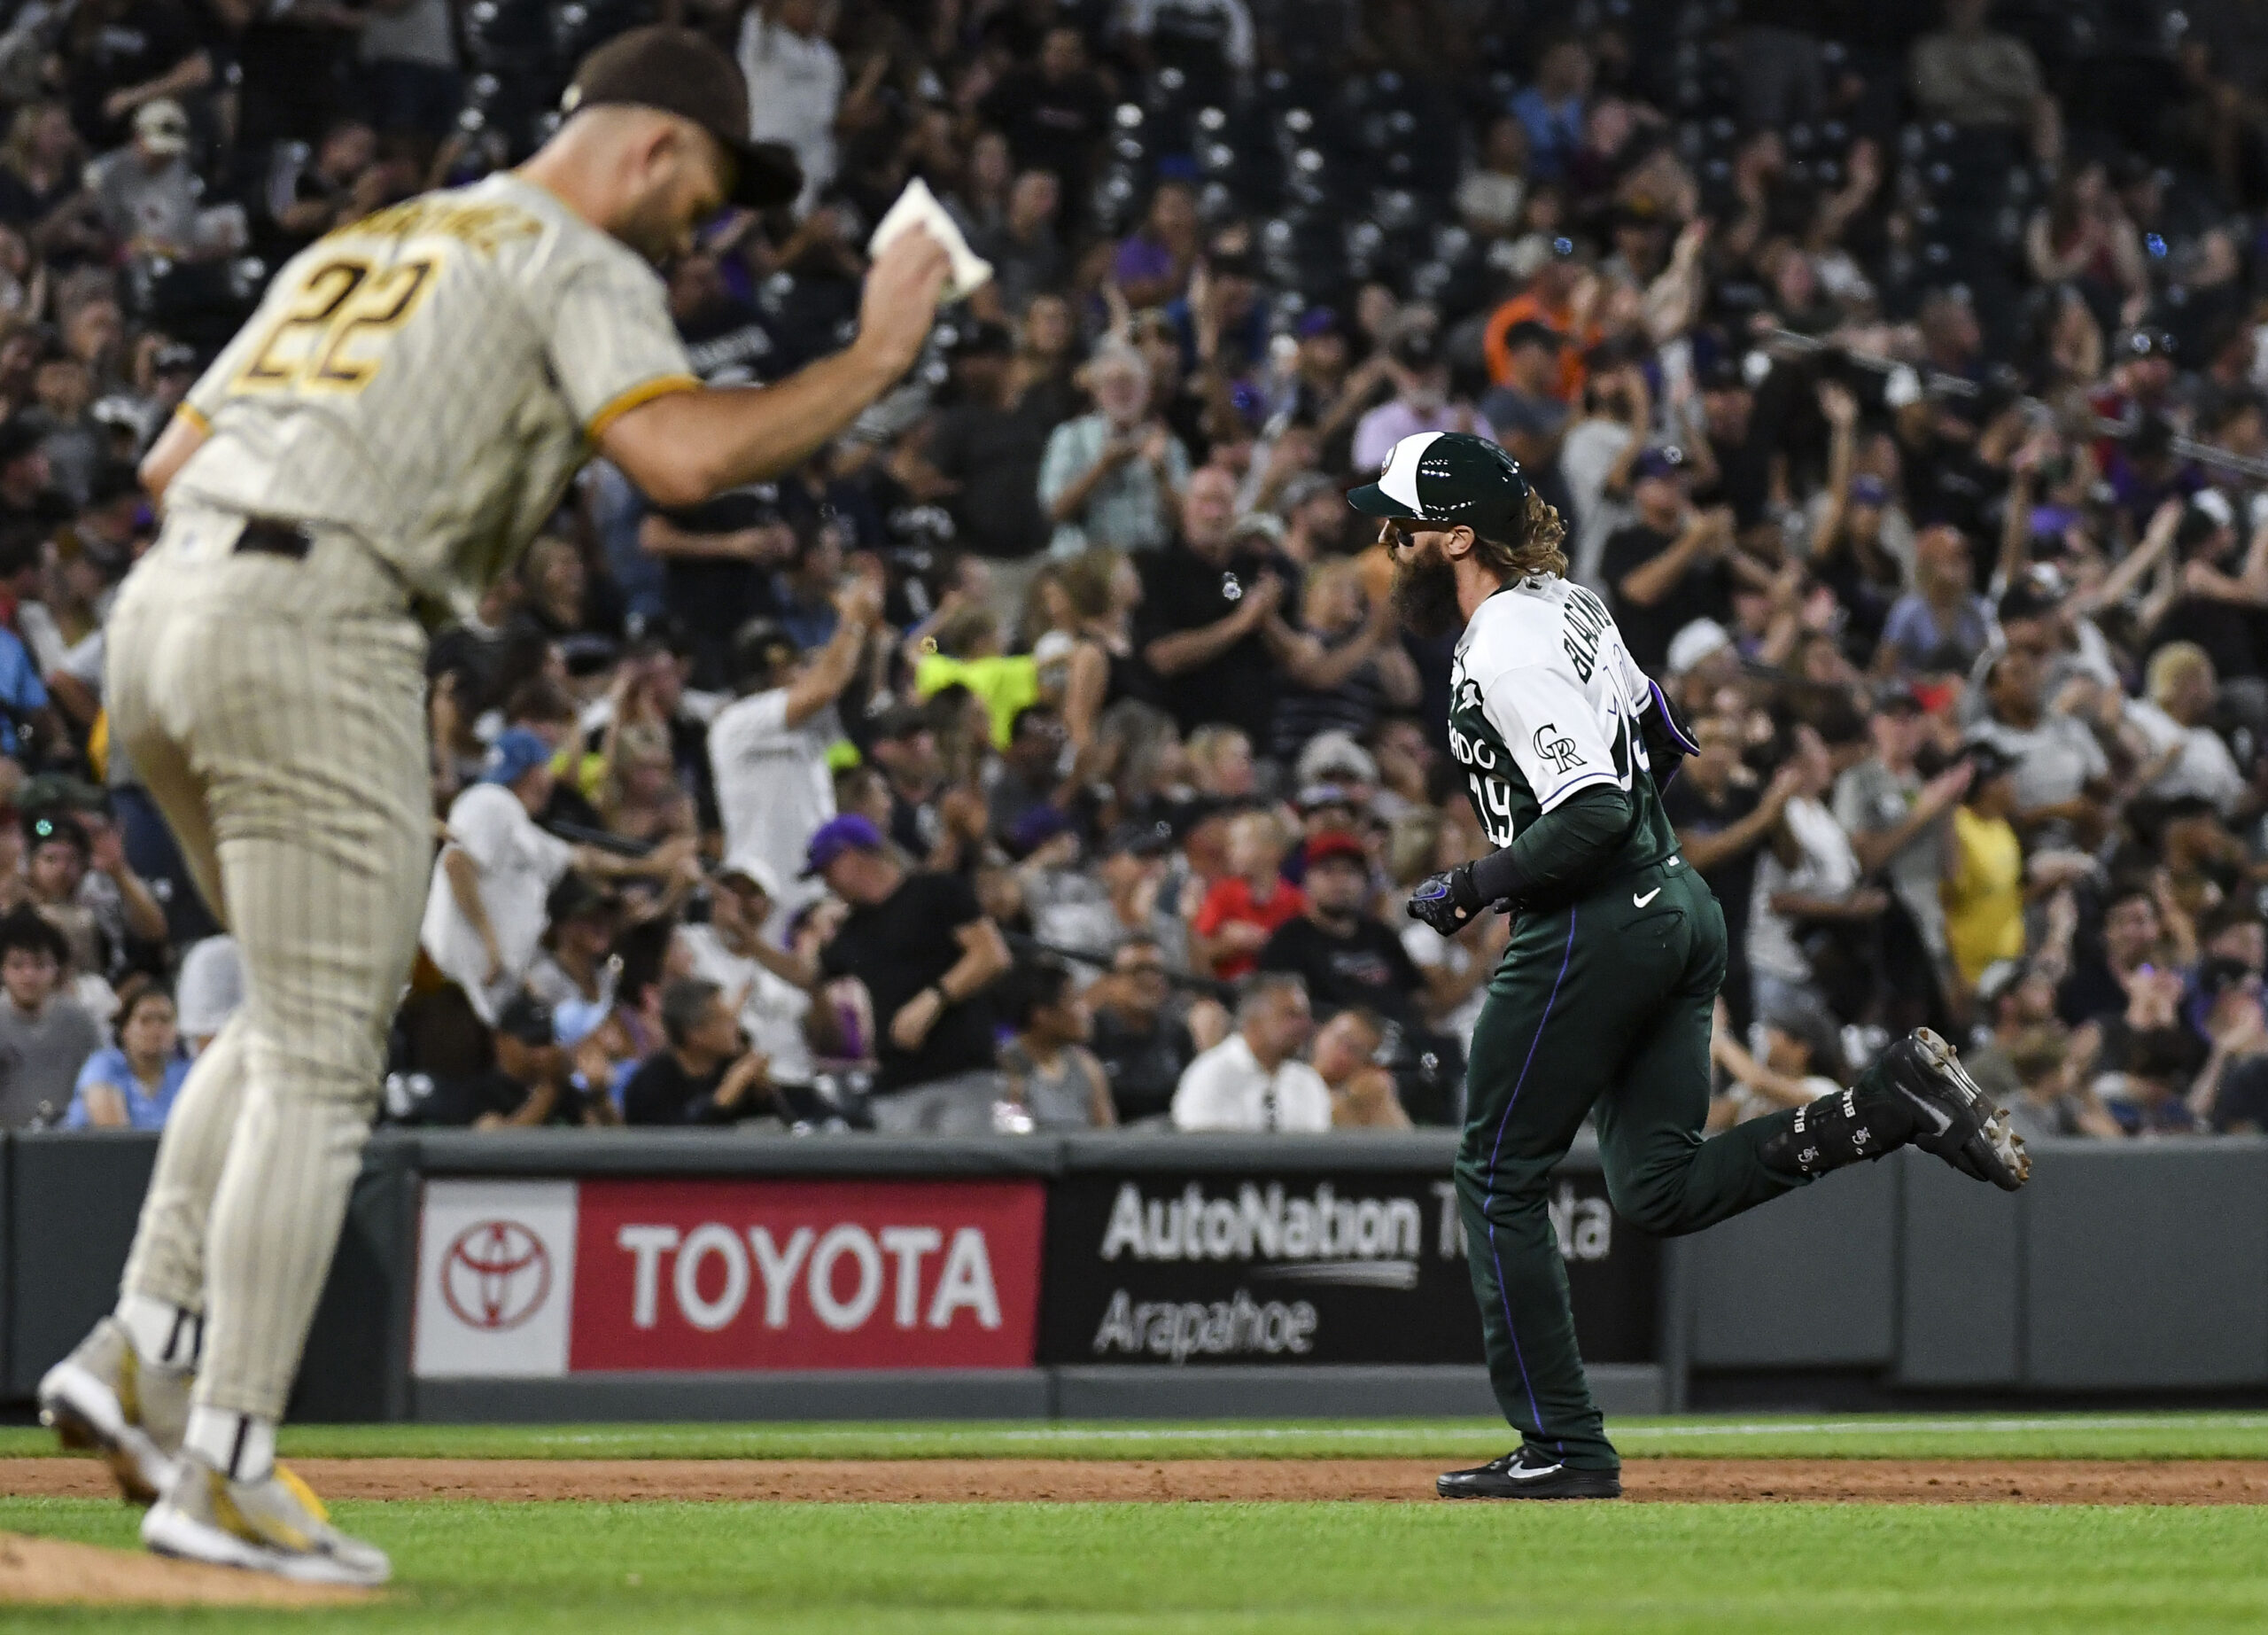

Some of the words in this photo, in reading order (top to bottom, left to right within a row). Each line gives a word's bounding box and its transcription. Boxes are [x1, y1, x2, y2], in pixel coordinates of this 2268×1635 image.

[228, 253, 445, 395] 22
[1448, 719, 1496, 769] ADO
[1534, 723, 1588, 775] CR
[1469, 772, 1514, 848] 19
[1100, 1182, 1421, 1260] AutoNation
[1432, 1181, 1612, 1259] Tta
[619, 1223, 1002, 1330] TOYOTA
[1093, 1289, 1318, 1366] Arapahoe
